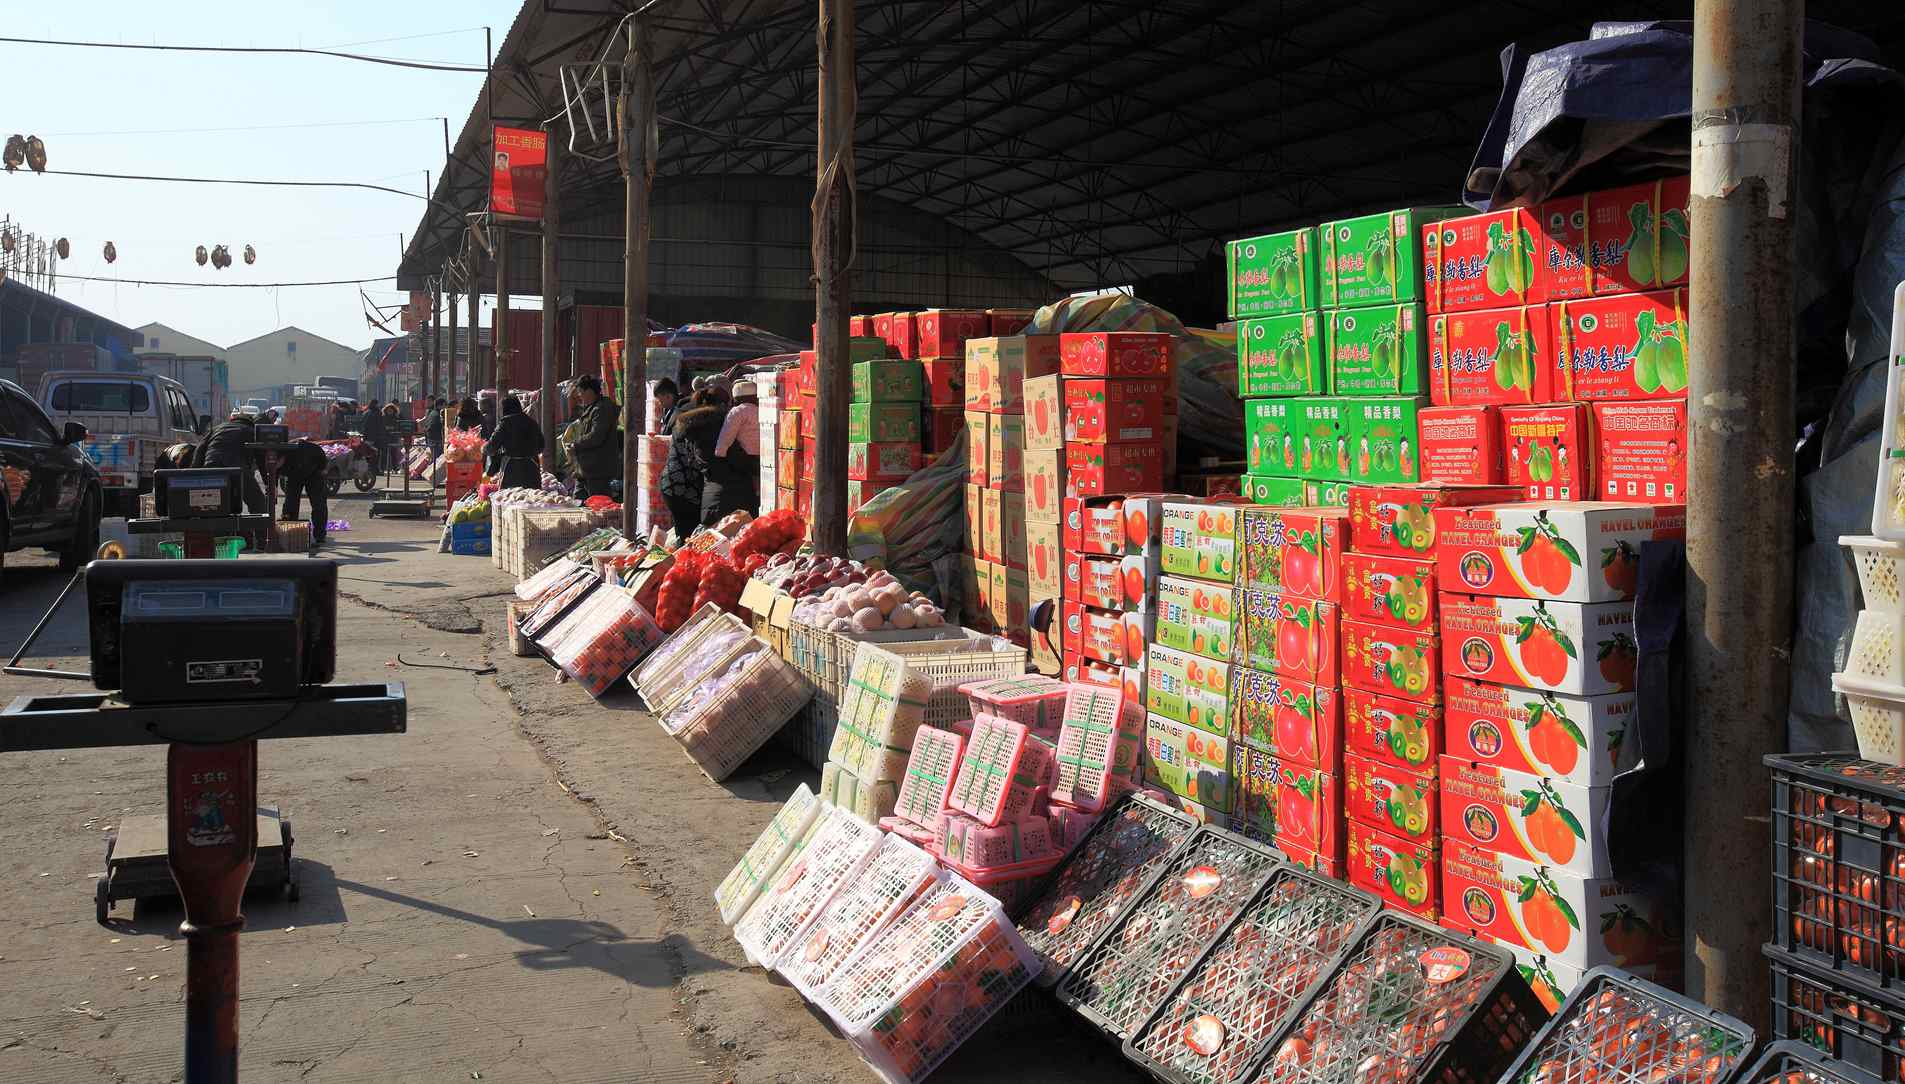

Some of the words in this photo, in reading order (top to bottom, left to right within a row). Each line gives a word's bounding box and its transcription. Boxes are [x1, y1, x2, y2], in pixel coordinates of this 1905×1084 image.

[1163, 509, 1194, 520] ORANGE
[1600, 519, 1634, 533] NAVEL
[1159, 582, 1190, 597] ORANGE
[1151, 650, 1184, 666] ORANGE
[1149, 719, 1183, 737] ORANGE
